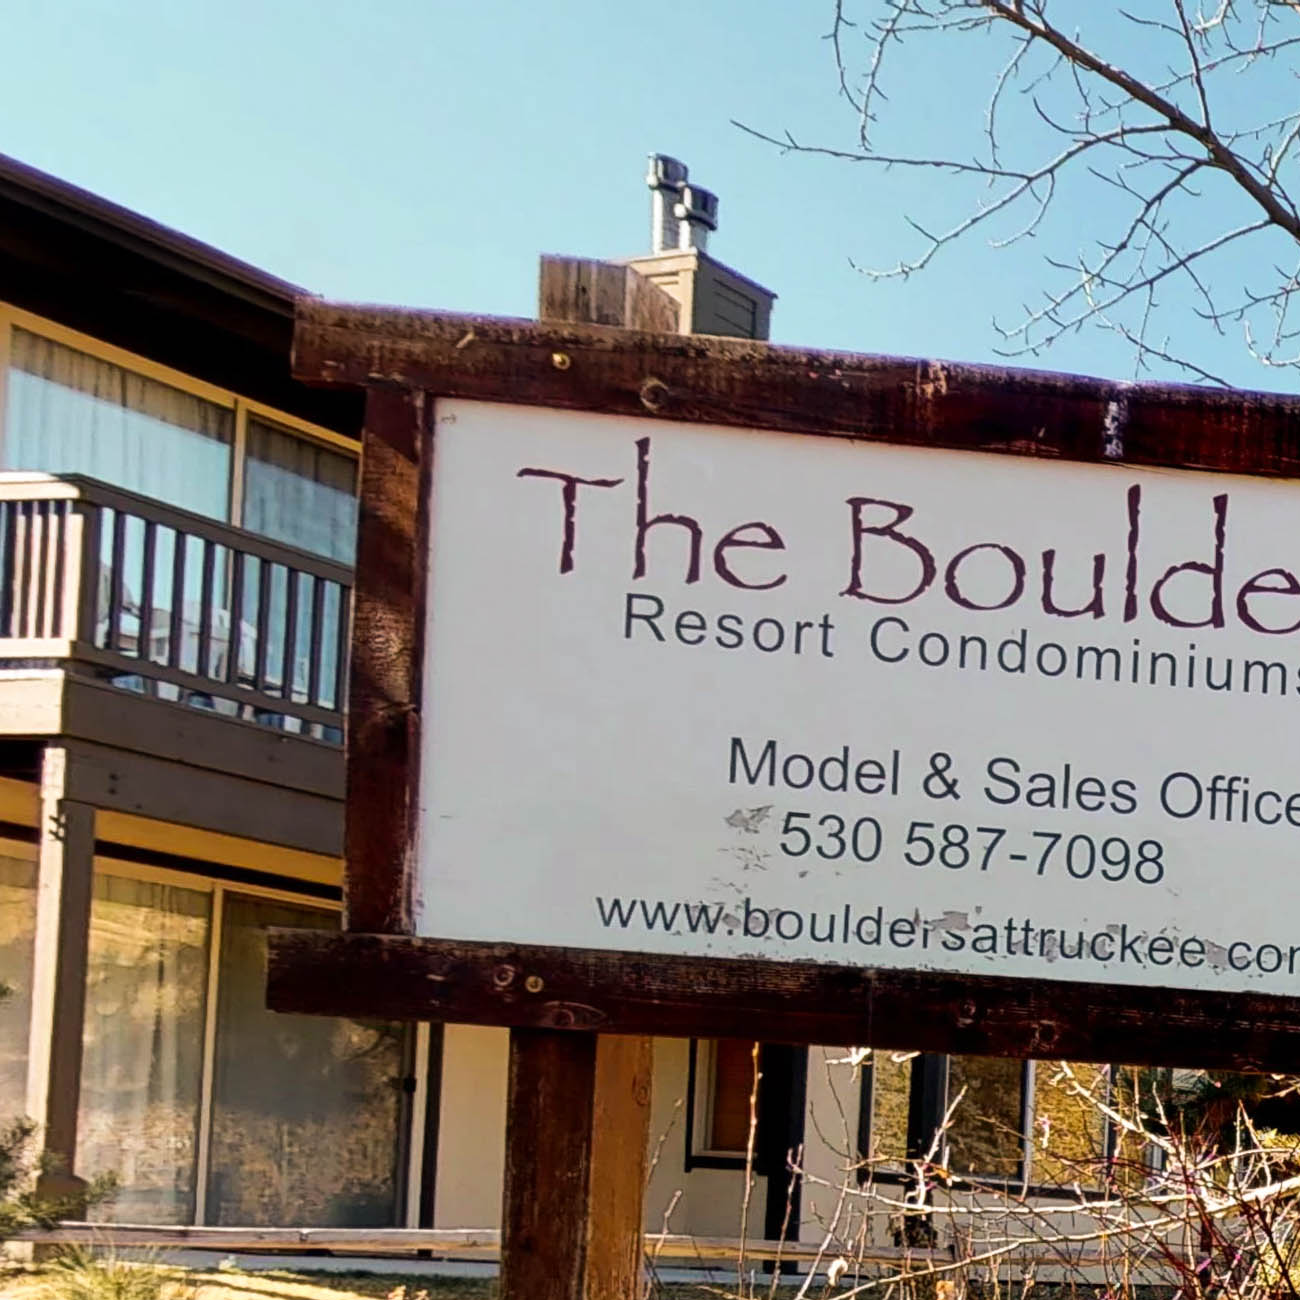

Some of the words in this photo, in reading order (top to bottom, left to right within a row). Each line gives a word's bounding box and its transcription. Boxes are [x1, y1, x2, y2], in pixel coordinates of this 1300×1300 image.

[516, 436, 789, 591] The
[623, 592, 836, 659] Resort
[728, 736, 900, 797] Model
[922, 752, 962, 802] &
[983, 757, 1138, 816] Sales
[779, 811, 884, 864] 530
[903, 821, 1166, 886] 587-7098
